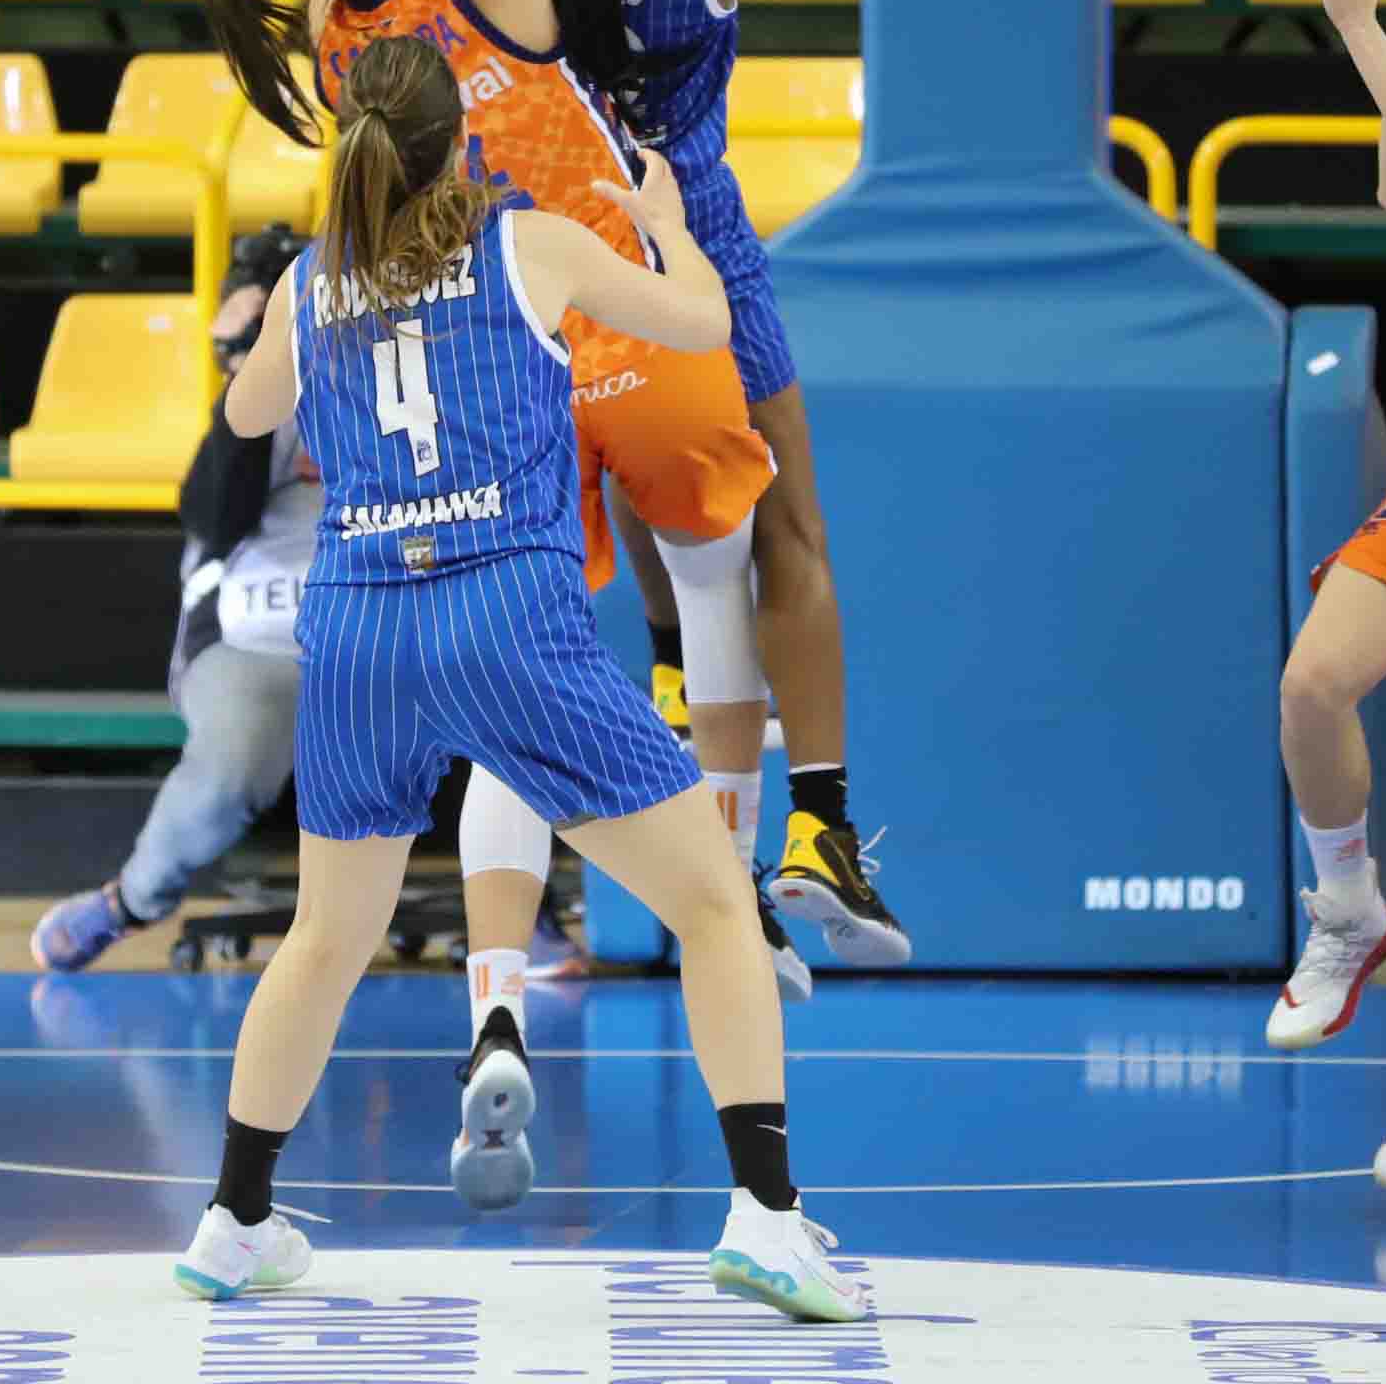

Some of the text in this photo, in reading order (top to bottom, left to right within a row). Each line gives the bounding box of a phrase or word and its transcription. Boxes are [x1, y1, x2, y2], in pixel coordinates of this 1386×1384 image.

[371, 318, 439, 478] 4
[341, 481, 503, 541] SALAMANCA
[1084, 876, 1245, 911] MONDO
